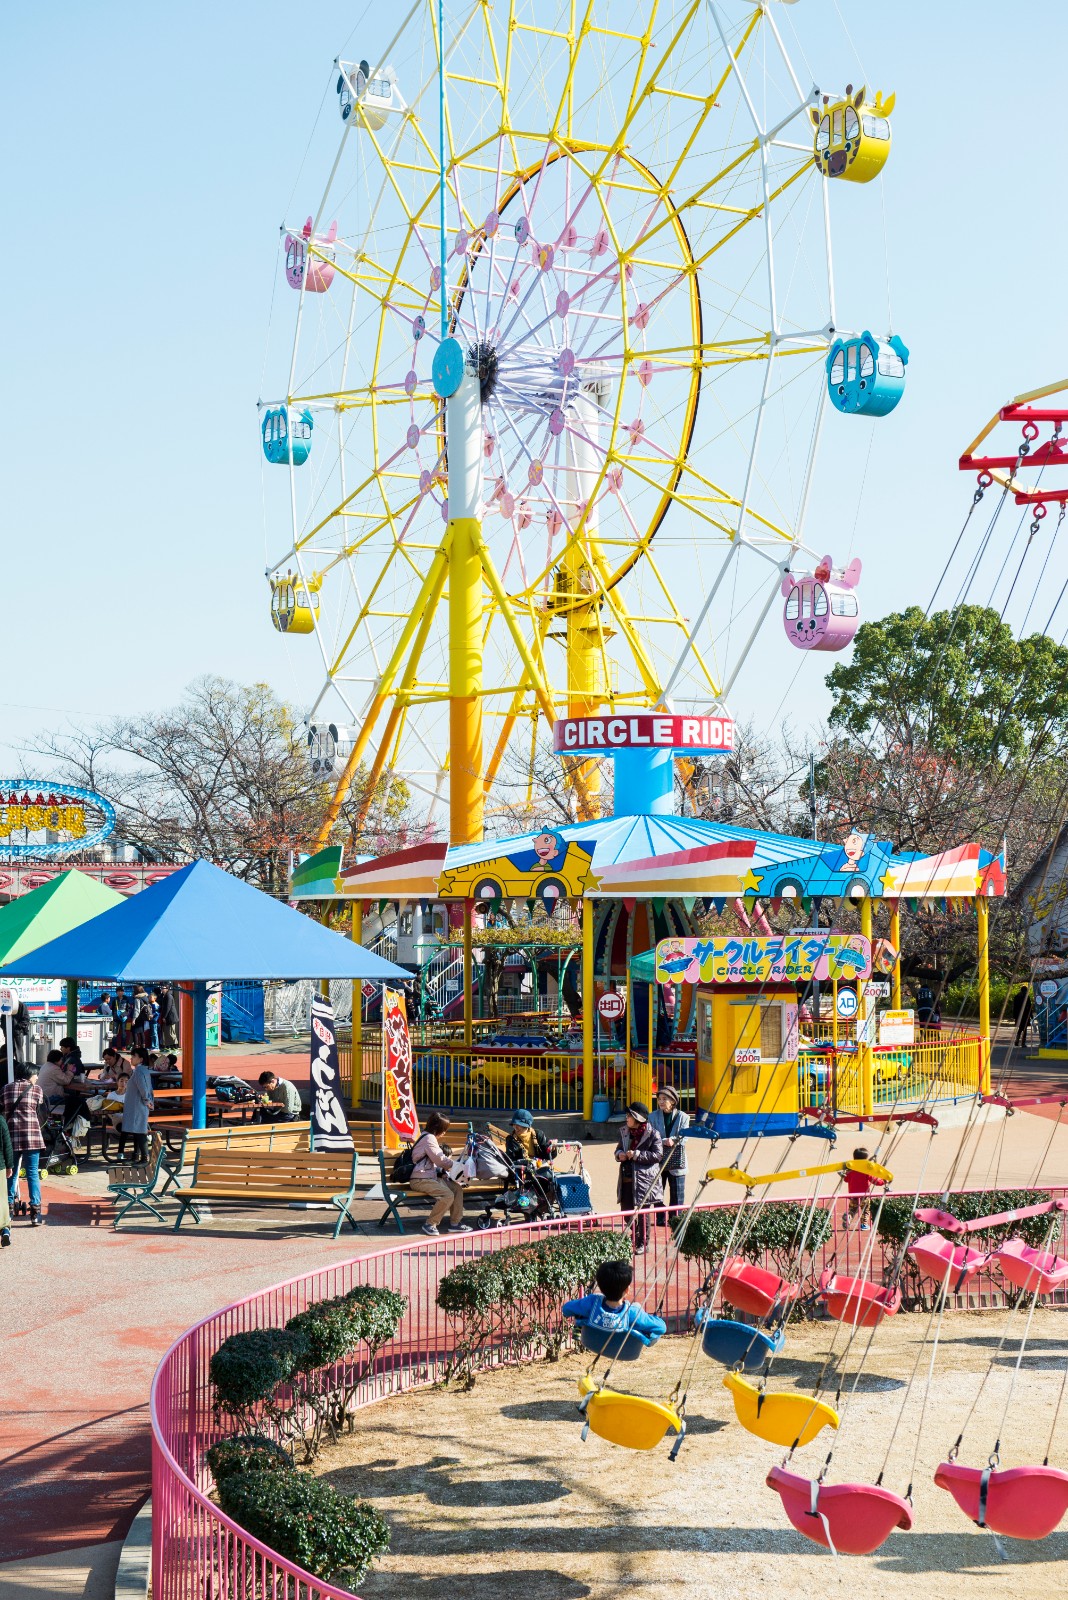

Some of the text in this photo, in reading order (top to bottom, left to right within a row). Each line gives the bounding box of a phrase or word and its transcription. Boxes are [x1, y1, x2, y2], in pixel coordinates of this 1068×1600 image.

[564, 719, 673, 746] CIRCLE
[691, 938, 836, 966] サークルライダー
[716, 965, 813, 976] CIRCLE RIDER
[600, 1000, 620, 1011] 出口
[839, 998, 854, 1008] 入口
